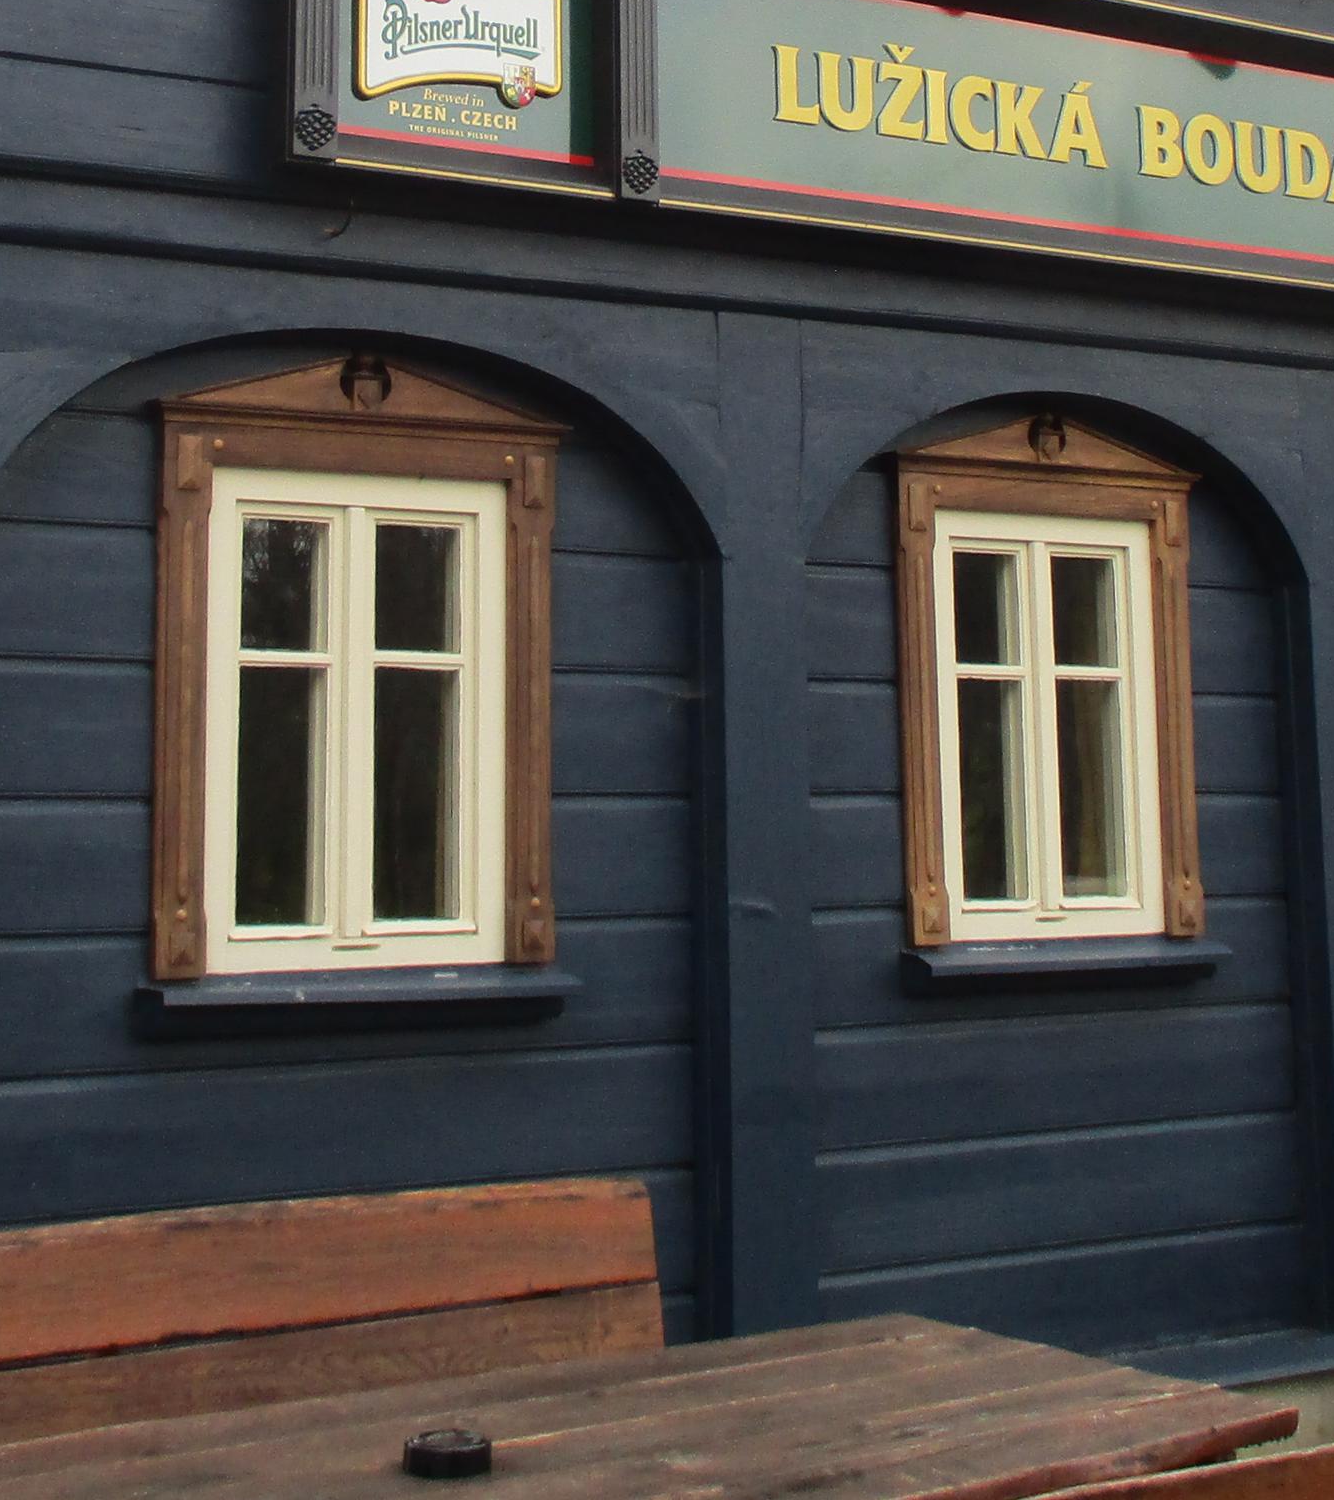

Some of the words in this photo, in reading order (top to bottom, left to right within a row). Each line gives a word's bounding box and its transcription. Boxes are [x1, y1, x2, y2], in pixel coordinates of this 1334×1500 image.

[460, 4, 538, 58] Urquell
[423, 88, 469, 106] Brewed
[472, 93, 484, 107] in
[771, 42, 1108, 169] LUŽICKÁ
[388, 99, 446, 122] PLZEŇ
[460, 109, 517, 131] CZECH
[409, 123, 424, 133] THE
[426, 125, 464, 138] ORIGINAL
[467, 130, 499, 141] PILSNER
